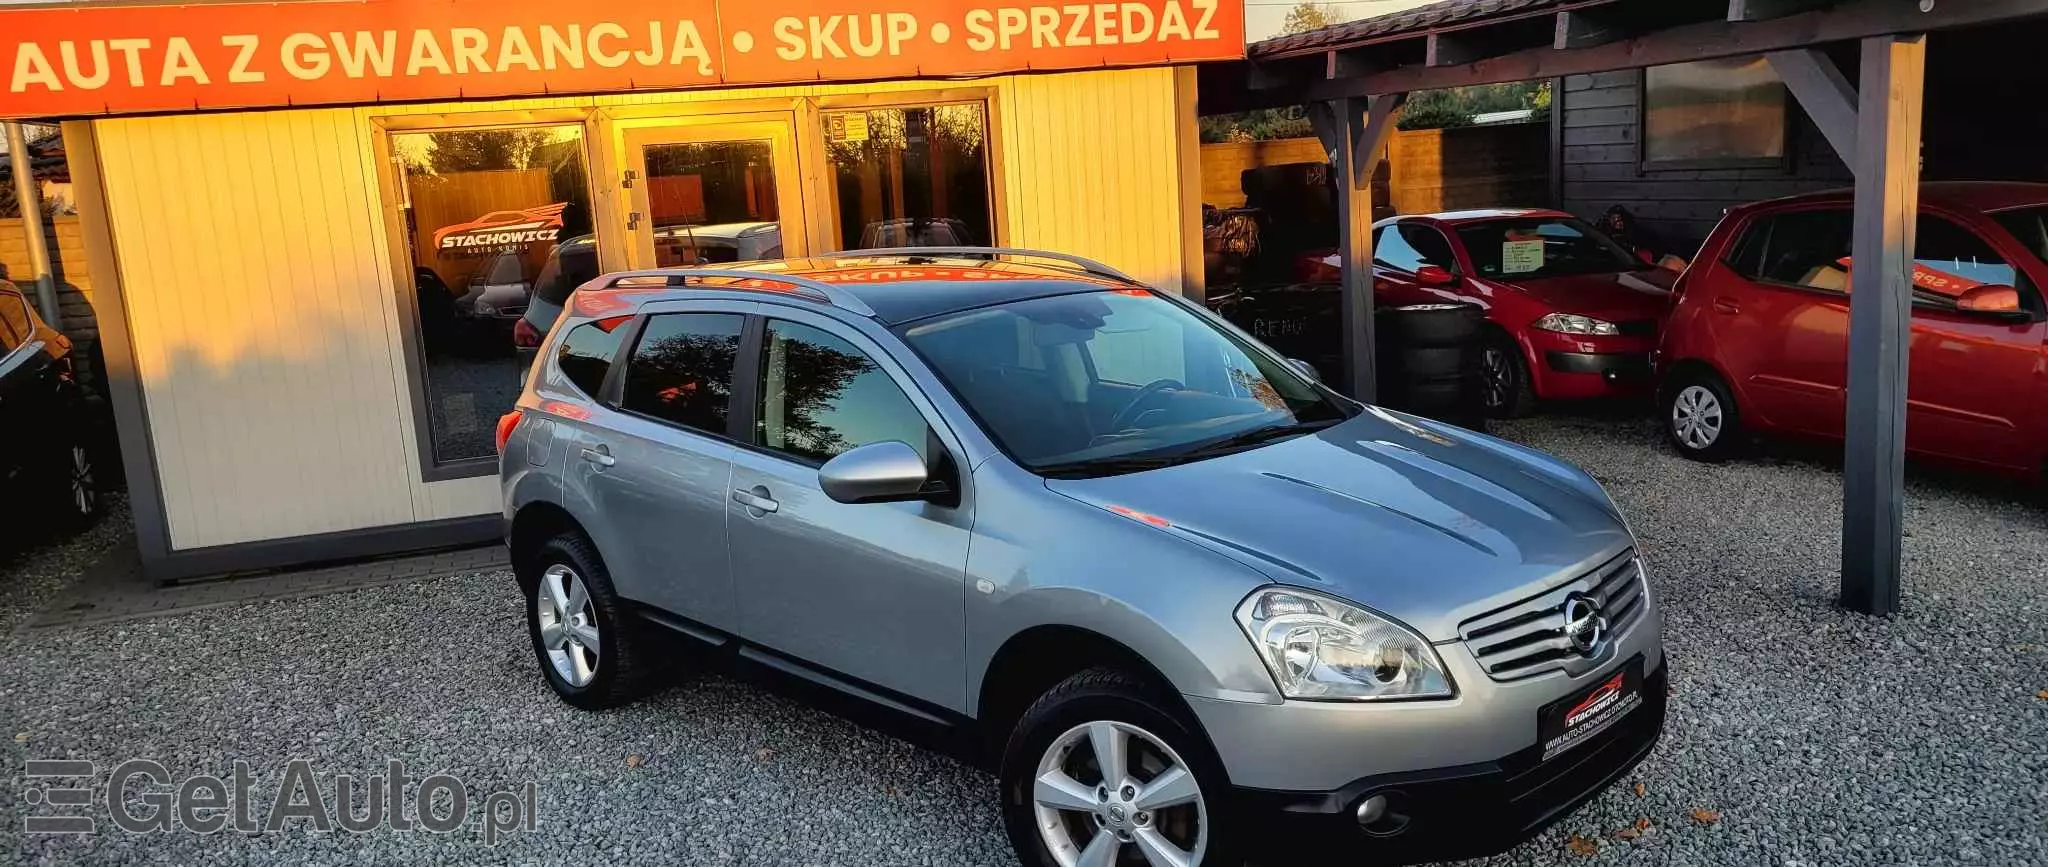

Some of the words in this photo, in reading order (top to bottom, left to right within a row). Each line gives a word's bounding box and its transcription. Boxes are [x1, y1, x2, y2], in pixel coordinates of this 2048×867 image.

[10, 37, 211, 93] AUTA
[221, 34, 265, 83] Z
[280, 19, 714, 80] GWARANCJĄ
[773, 14, 918, 61] SKUP
[442, 229, 560, 248] STACHOWICZ
